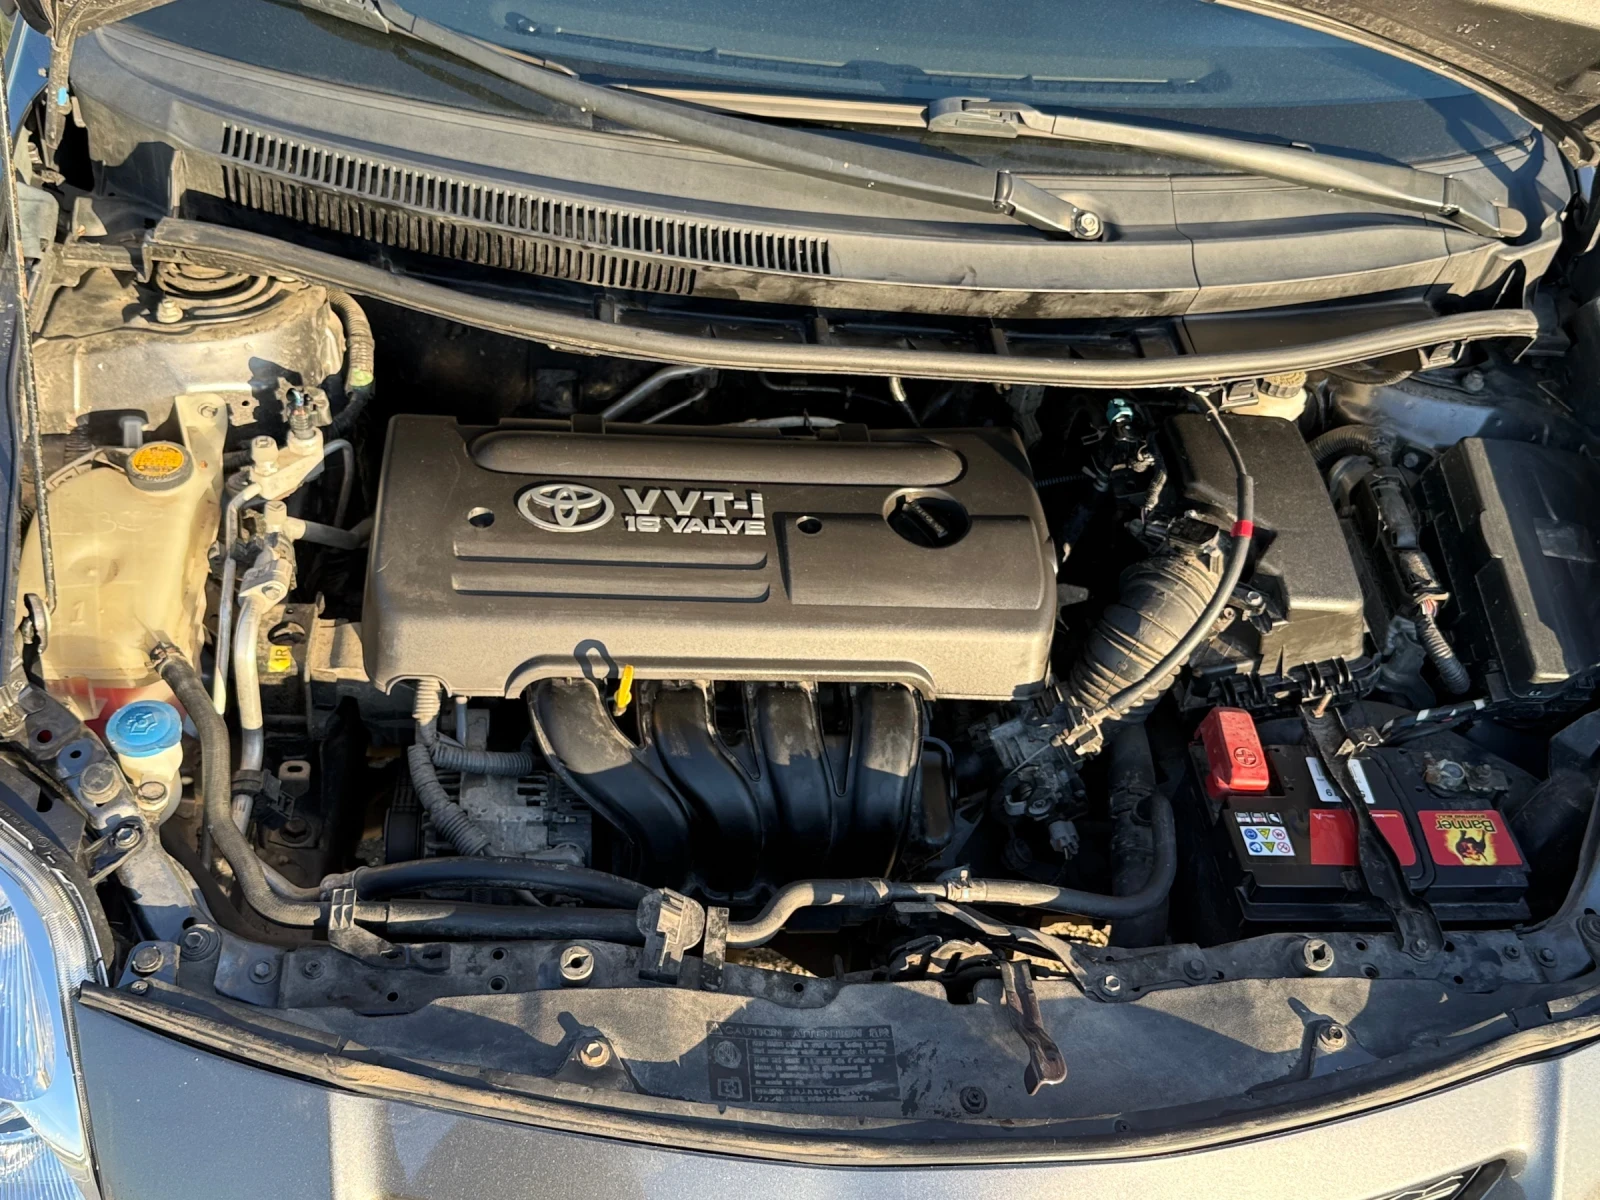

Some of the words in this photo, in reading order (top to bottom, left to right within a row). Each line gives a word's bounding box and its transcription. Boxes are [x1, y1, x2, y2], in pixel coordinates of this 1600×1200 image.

[624, 515, 662, 532] 16
[665, 517, 767, 535] VALVE
[1436, 819, 1497, 833] Banner
[725, 1025, 782, 1037] CAUTION
[792, 1026, 862, 1038] ATTENTION
